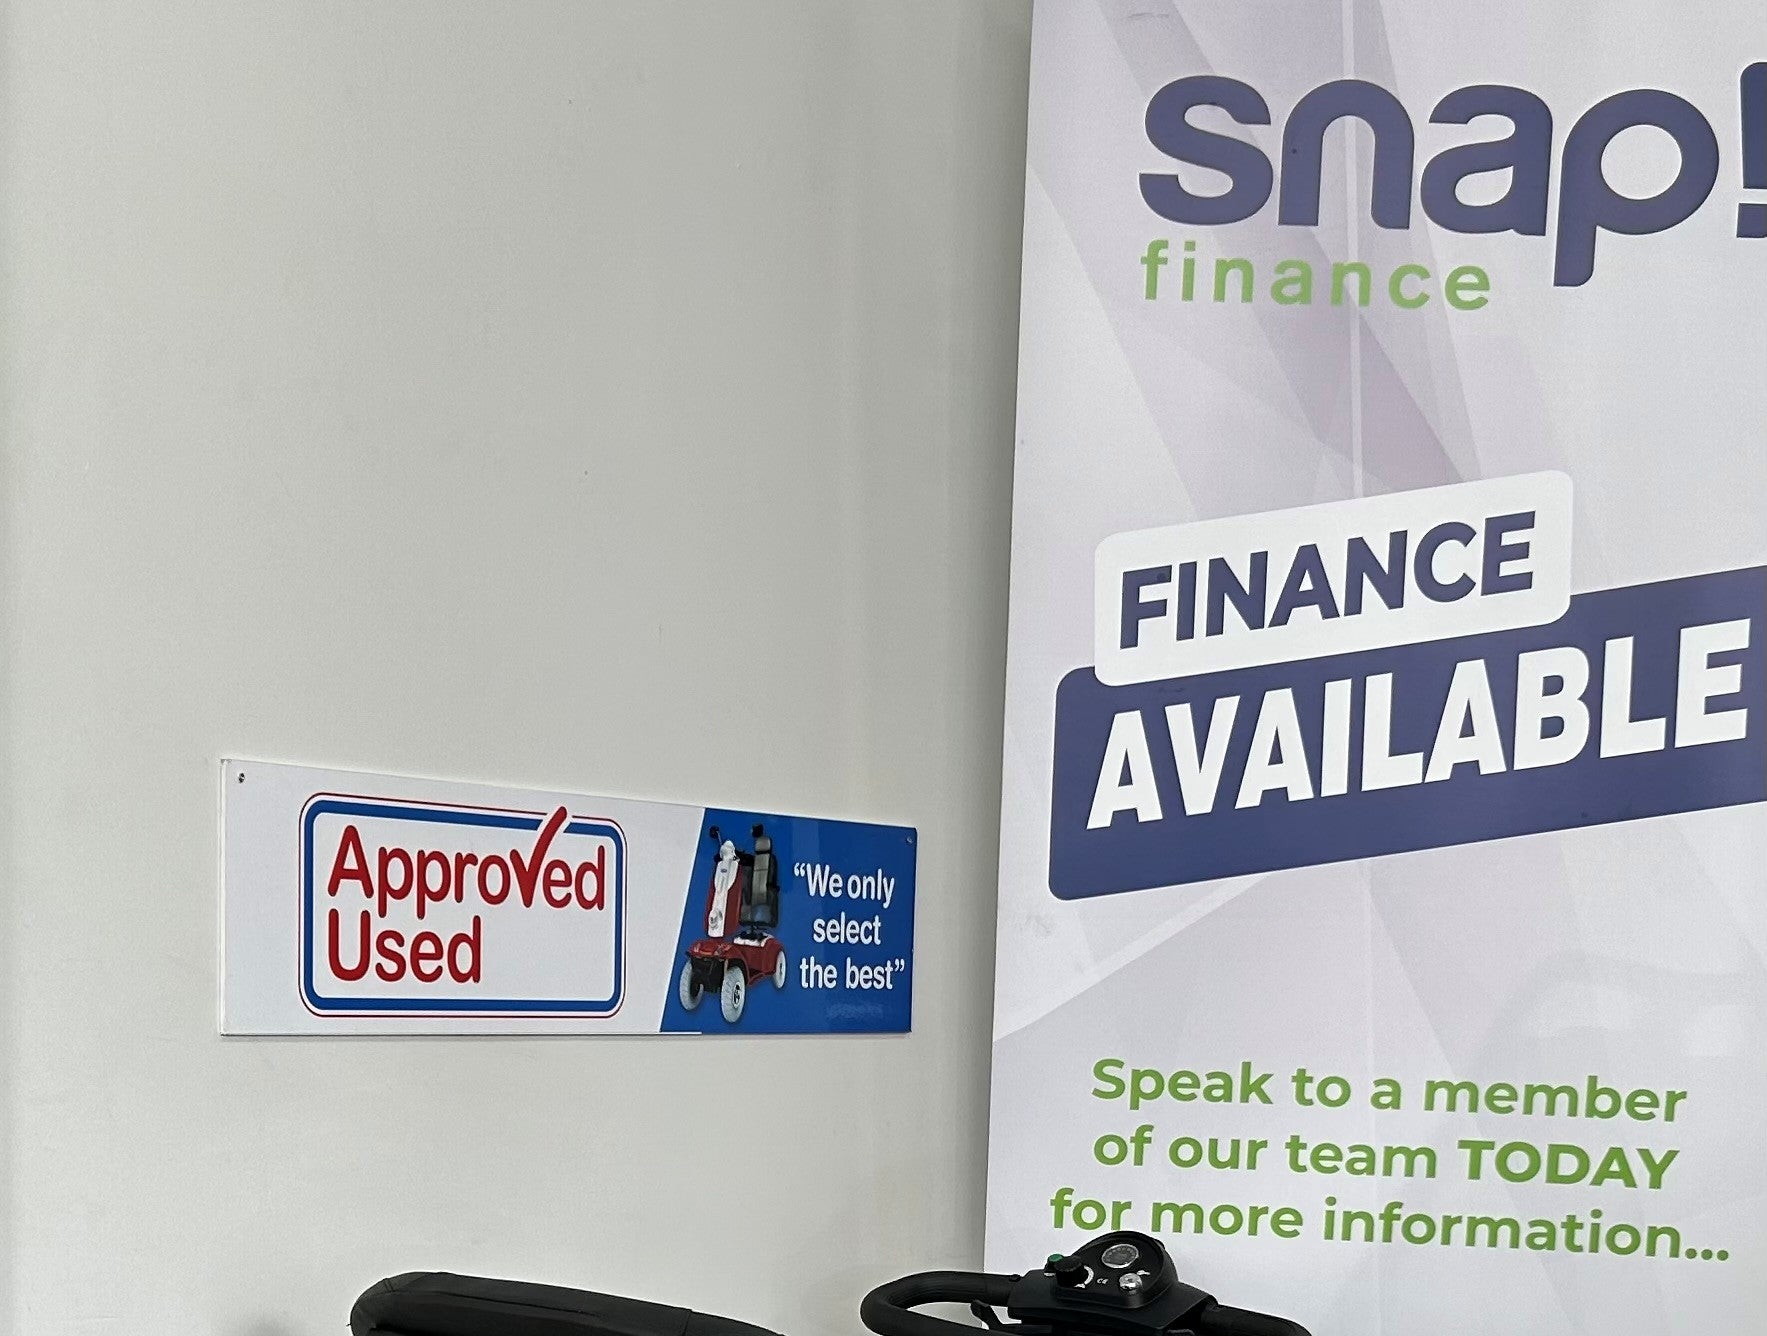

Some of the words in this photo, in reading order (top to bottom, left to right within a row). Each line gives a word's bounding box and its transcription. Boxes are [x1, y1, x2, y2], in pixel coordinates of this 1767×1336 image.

[1140, 239, 1491, 310] finance
[1120, 510, 1536, 650] FINANCE
[1086, 618, 1752, 830] AVAILABLE
[327, 806, 606, 920] Approved
[847, 868, 896, 909] only
[327, 908, 482, 984] Used
[813, 914, 882, 946] select
[799, 957, 838, 989] the
[1092, 1058, 1273, 1110] Speak
[1292, 1067, 1351, 1109] to
[1370, 1077, 1402, 1110] a
[1424, 1074, 1688, 1122] member
[1093, 1124, 1153, 1167] of
[1168, 1135, 1269, 1171] our
[1286, 1134, 1438, 1179] team
[1457, 1139, 1680, 1190] TODAY
[1050, 1187, 1132, 1232] for
[1150, 1201, 1304, 1240] more
[1323, 1196, 1730, 1262] information...
